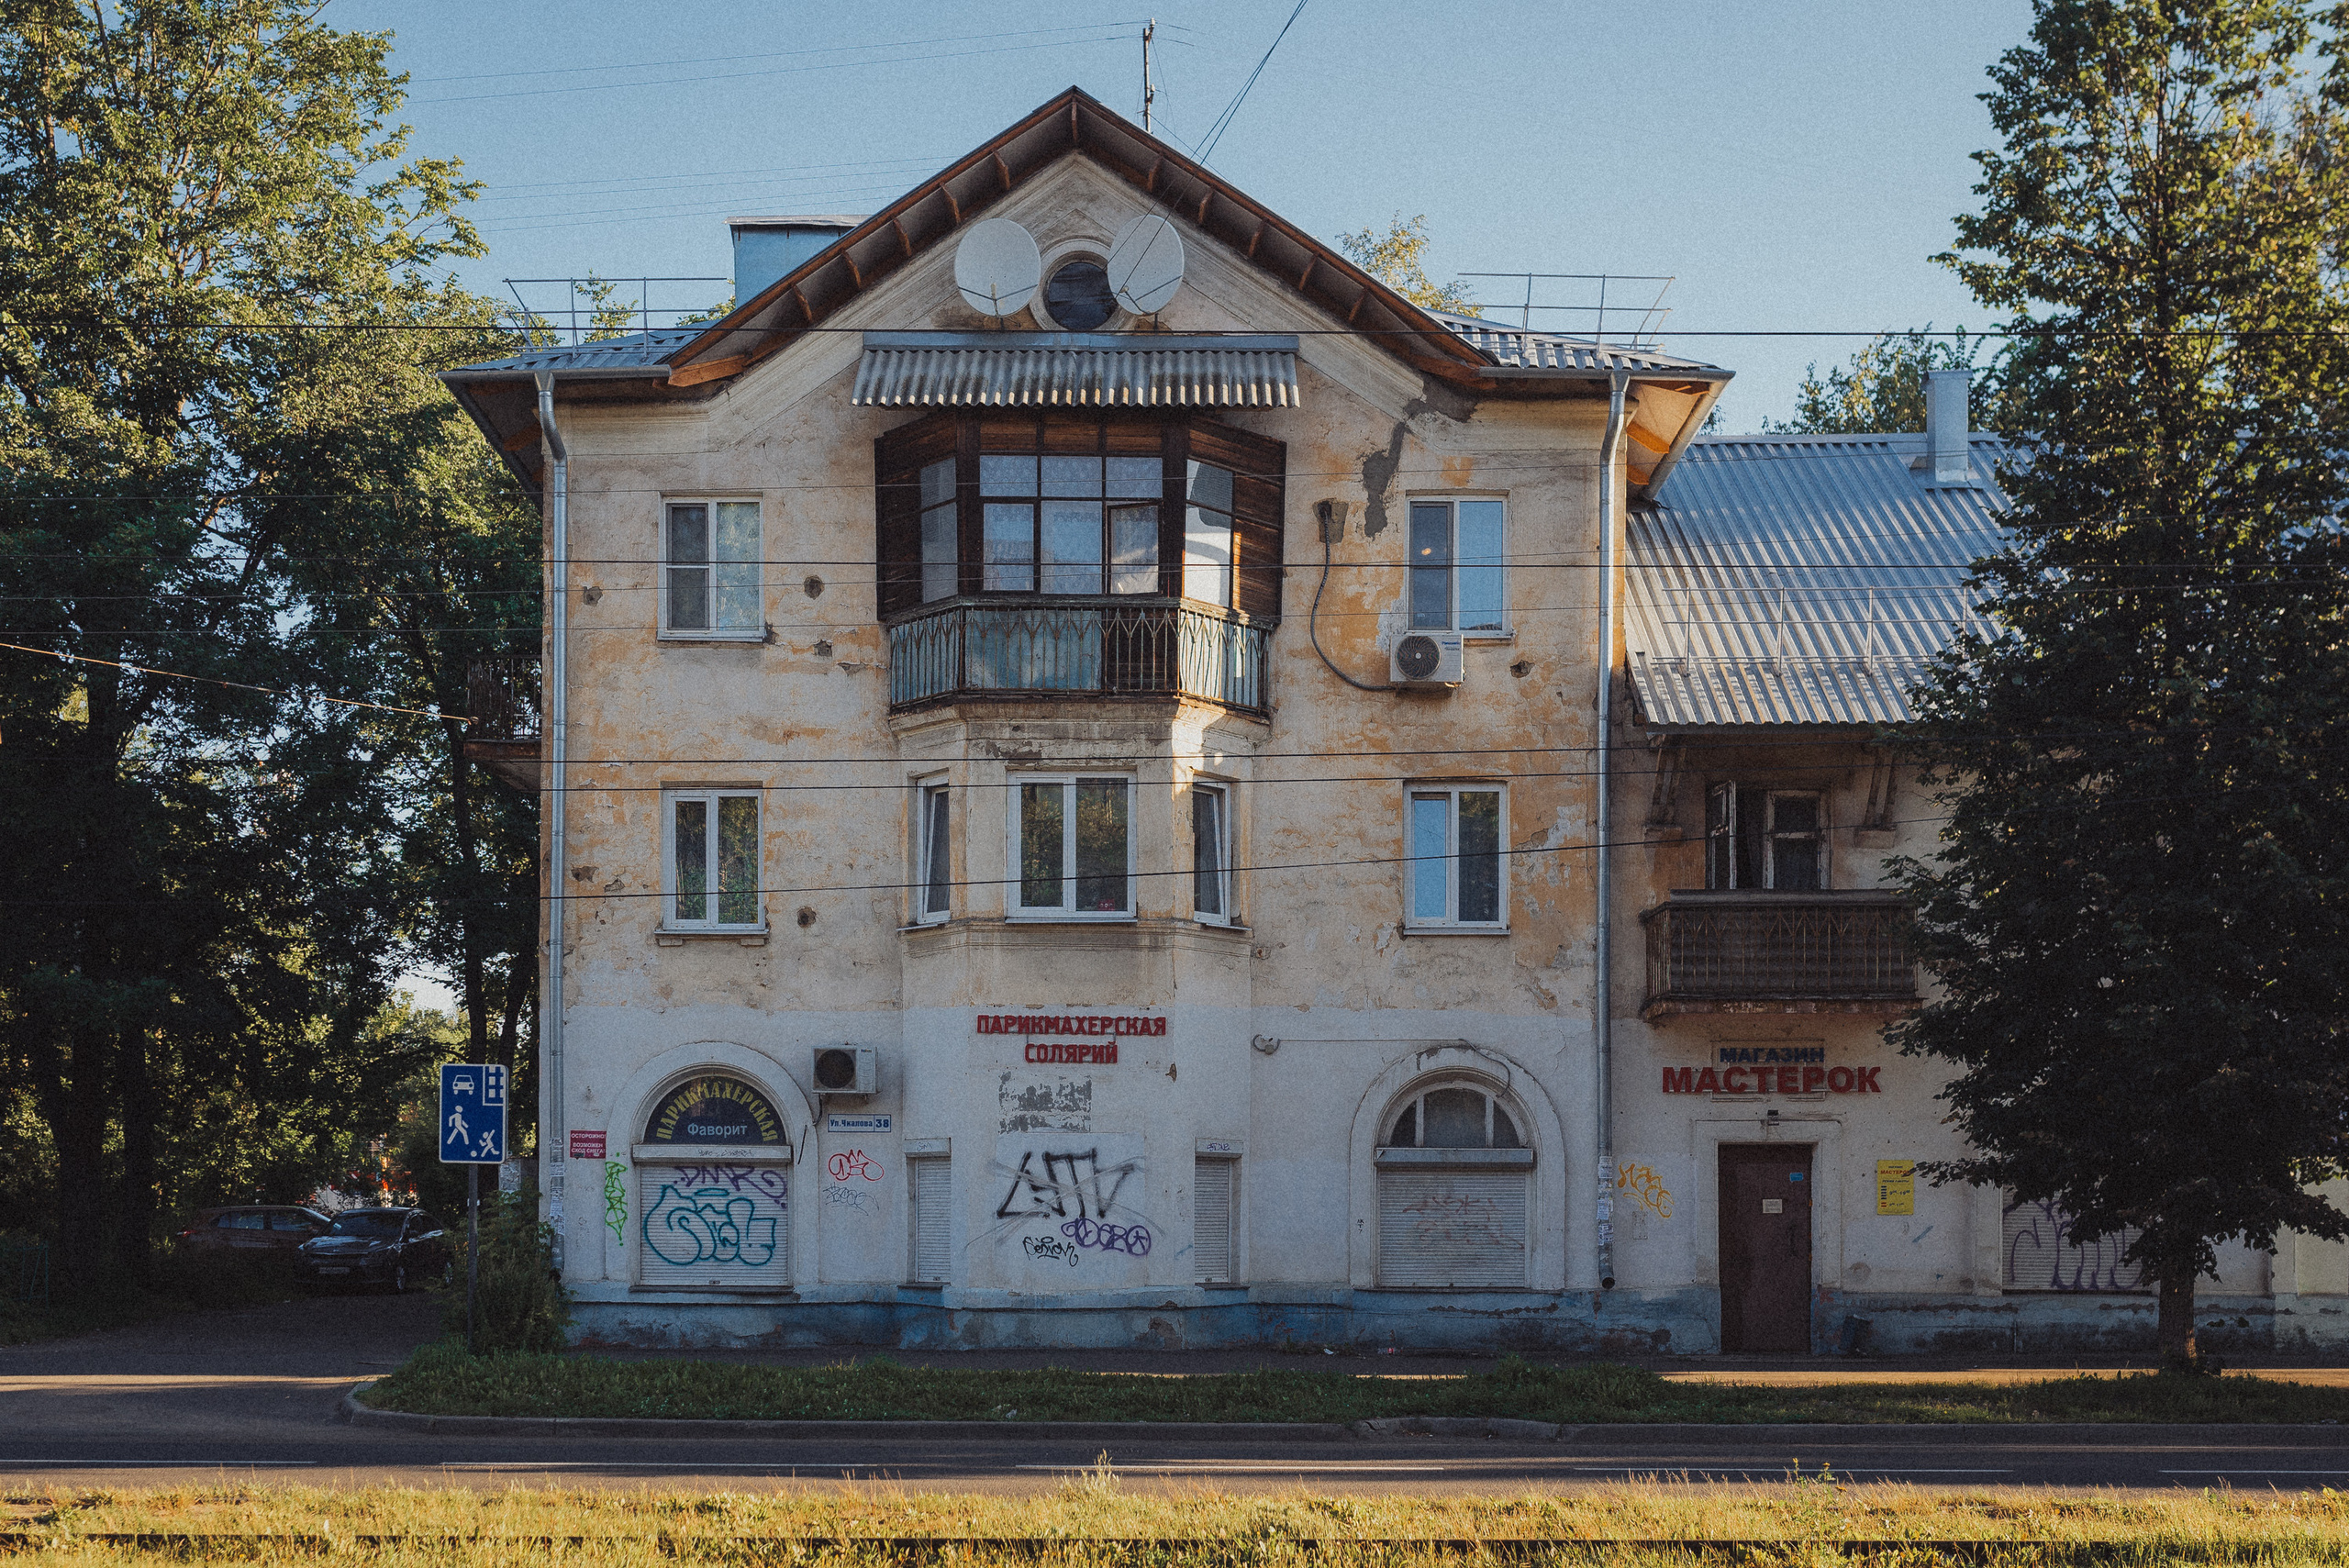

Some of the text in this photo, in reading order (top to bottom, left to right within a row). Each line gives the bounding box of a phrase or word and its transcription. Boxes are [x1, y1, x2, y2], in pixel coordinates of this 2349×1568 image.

[976, 1014, 1167, 1036] ПАРИКМАХЕРСКАЯ
[1025, 1040, 1119, 1064] СОЛЯРИЙ
[1720, 1047, 1825, 1063] МАГАЗИН
[1662, 1065, 1882, 1094] МАСТЕРОК
[655, 1081, 779, 1142] ПАРИКМАХЕРСКАЯ
[687, 1122, 748, 1139] Фаворит
[875, 1118, 890, 1129] 38
